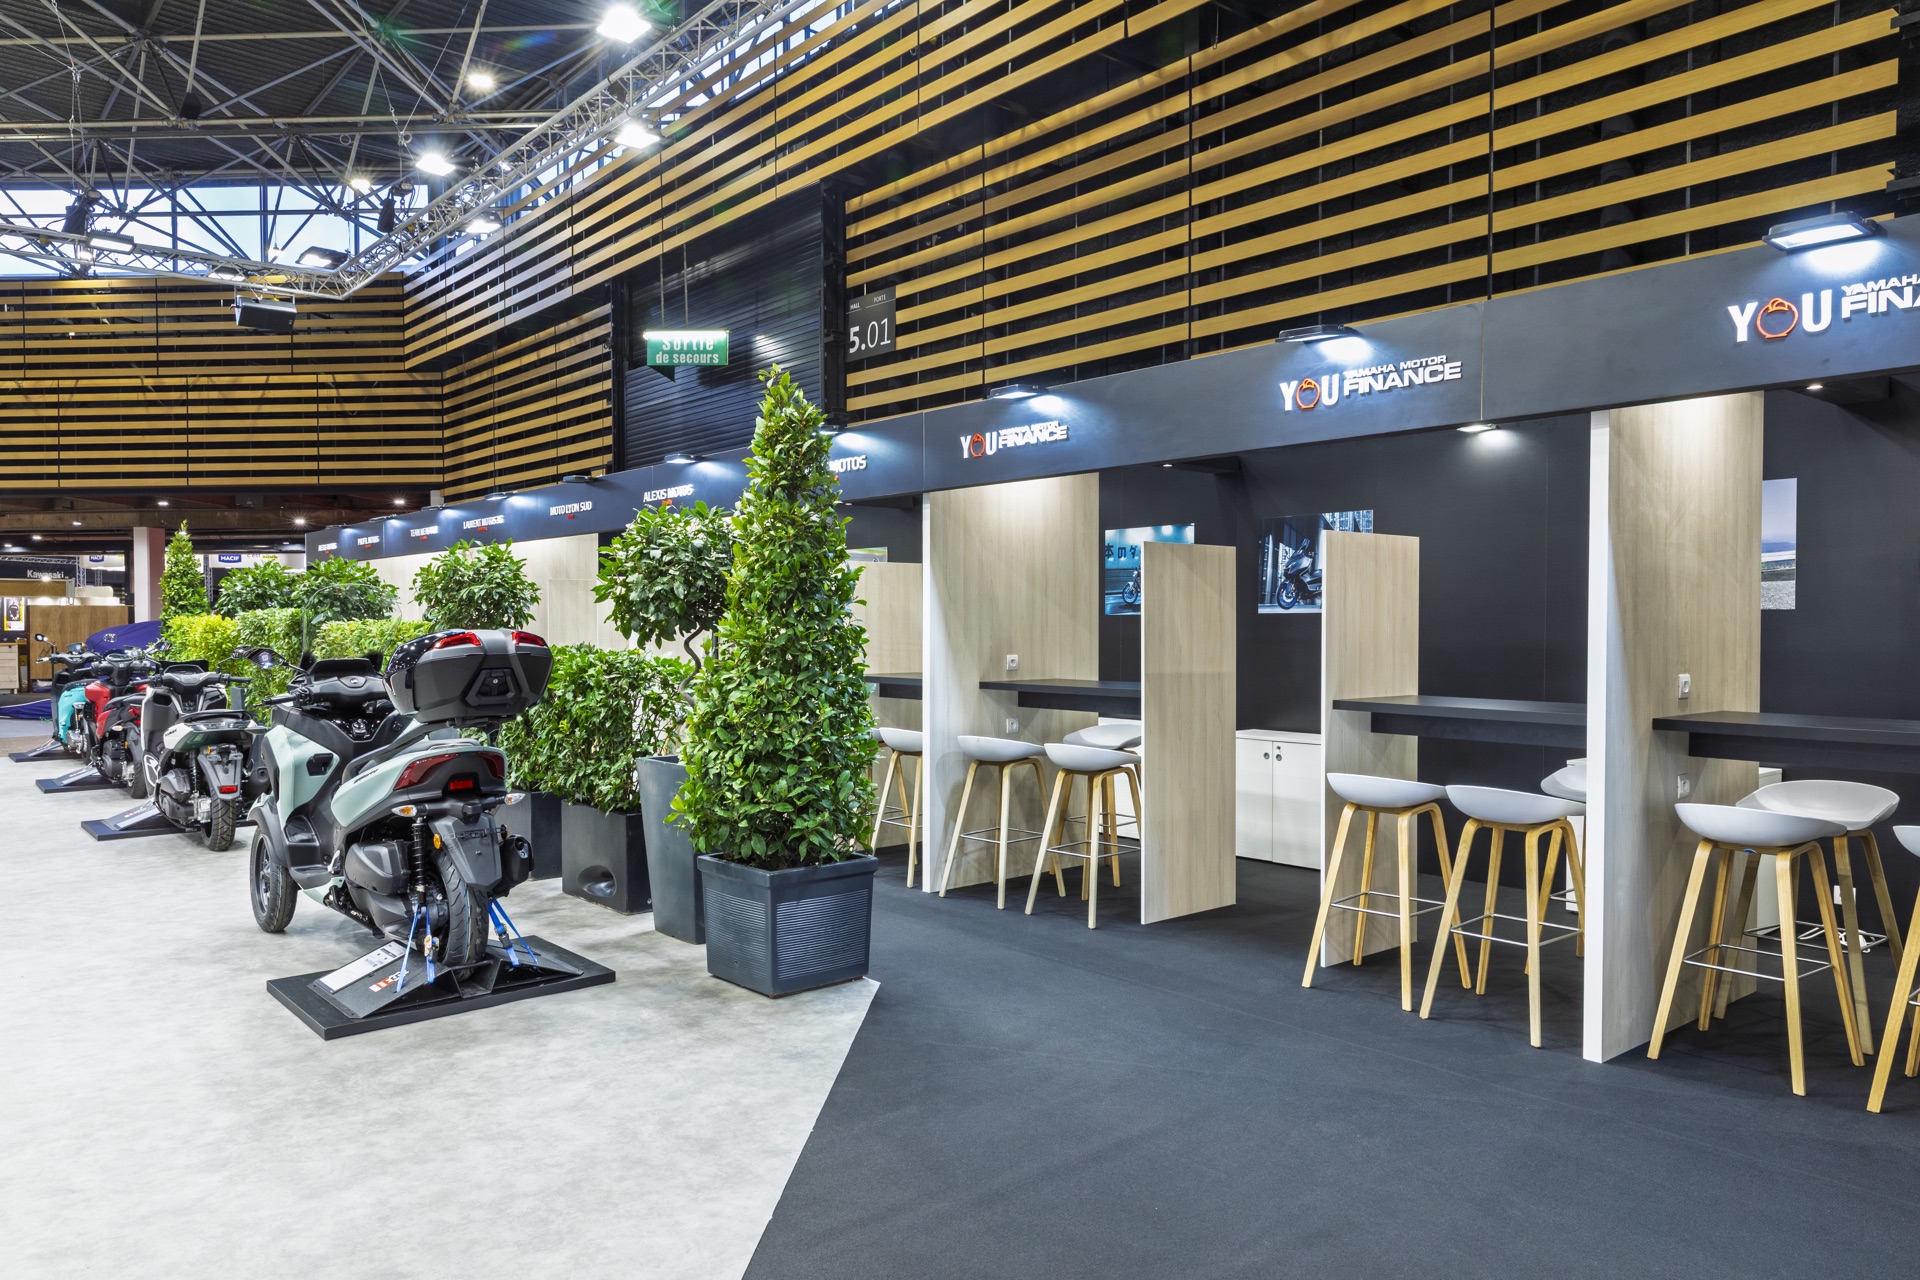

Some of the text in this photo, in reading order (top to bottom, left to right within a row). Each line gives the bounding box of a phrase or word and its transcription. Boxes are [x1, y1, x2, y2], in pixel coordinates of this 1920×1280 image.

[873, 294, 887, 303] PORTE
[1727, 289, 1833, 343] YOU
[849, 317, 891, 353] 5.01
[655, 351, 719, 364] de secours
[1343, 354, 1447, 379] YAMAHA MOTOR
[1279, 361, 1462, 411] YOU FINANCE
[643, 489, 667, 502] ALEXIS
[549, 500, 592, 516] MOTO LYON SUD
[27, 569, 64, 579] Kawasaki
